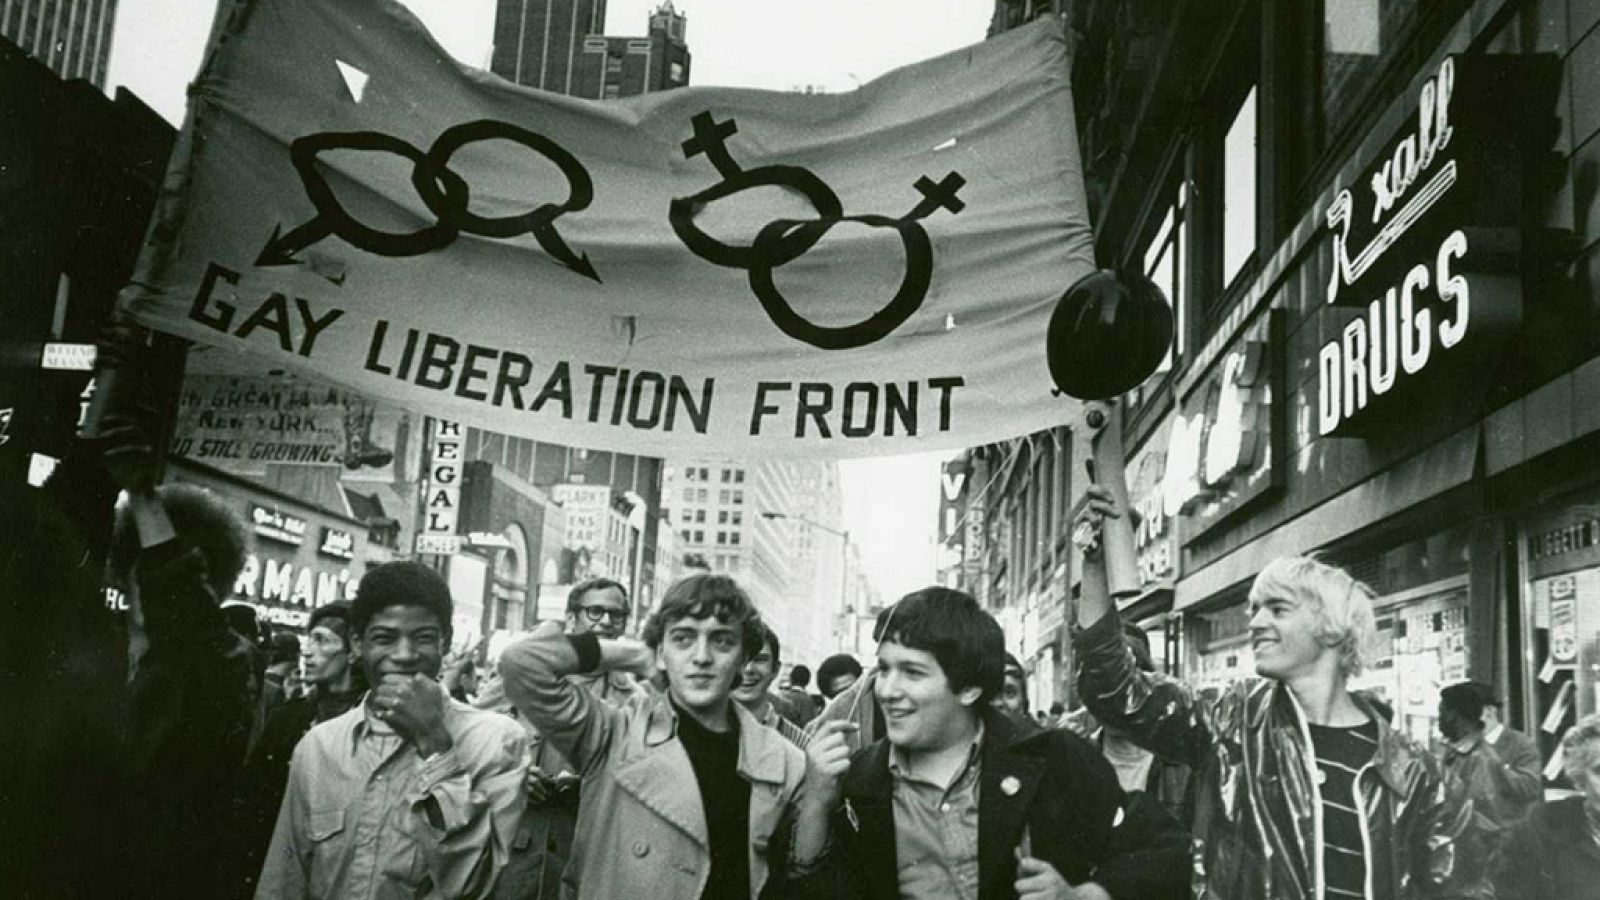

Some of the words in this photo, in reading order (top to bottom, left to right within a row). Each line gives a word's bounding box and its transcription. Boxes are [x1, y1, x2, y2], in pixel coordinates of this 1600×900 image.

[188, 261, 345, 359] GAY
[364, 320, 715, 435] LIBERATION
[749, 375, 965, 440] FRONT
[1319, 229, 1470, 436] DRUGS
[196, 438, 243, 459] STILL
[428, 420, 460, 532] REGAL
